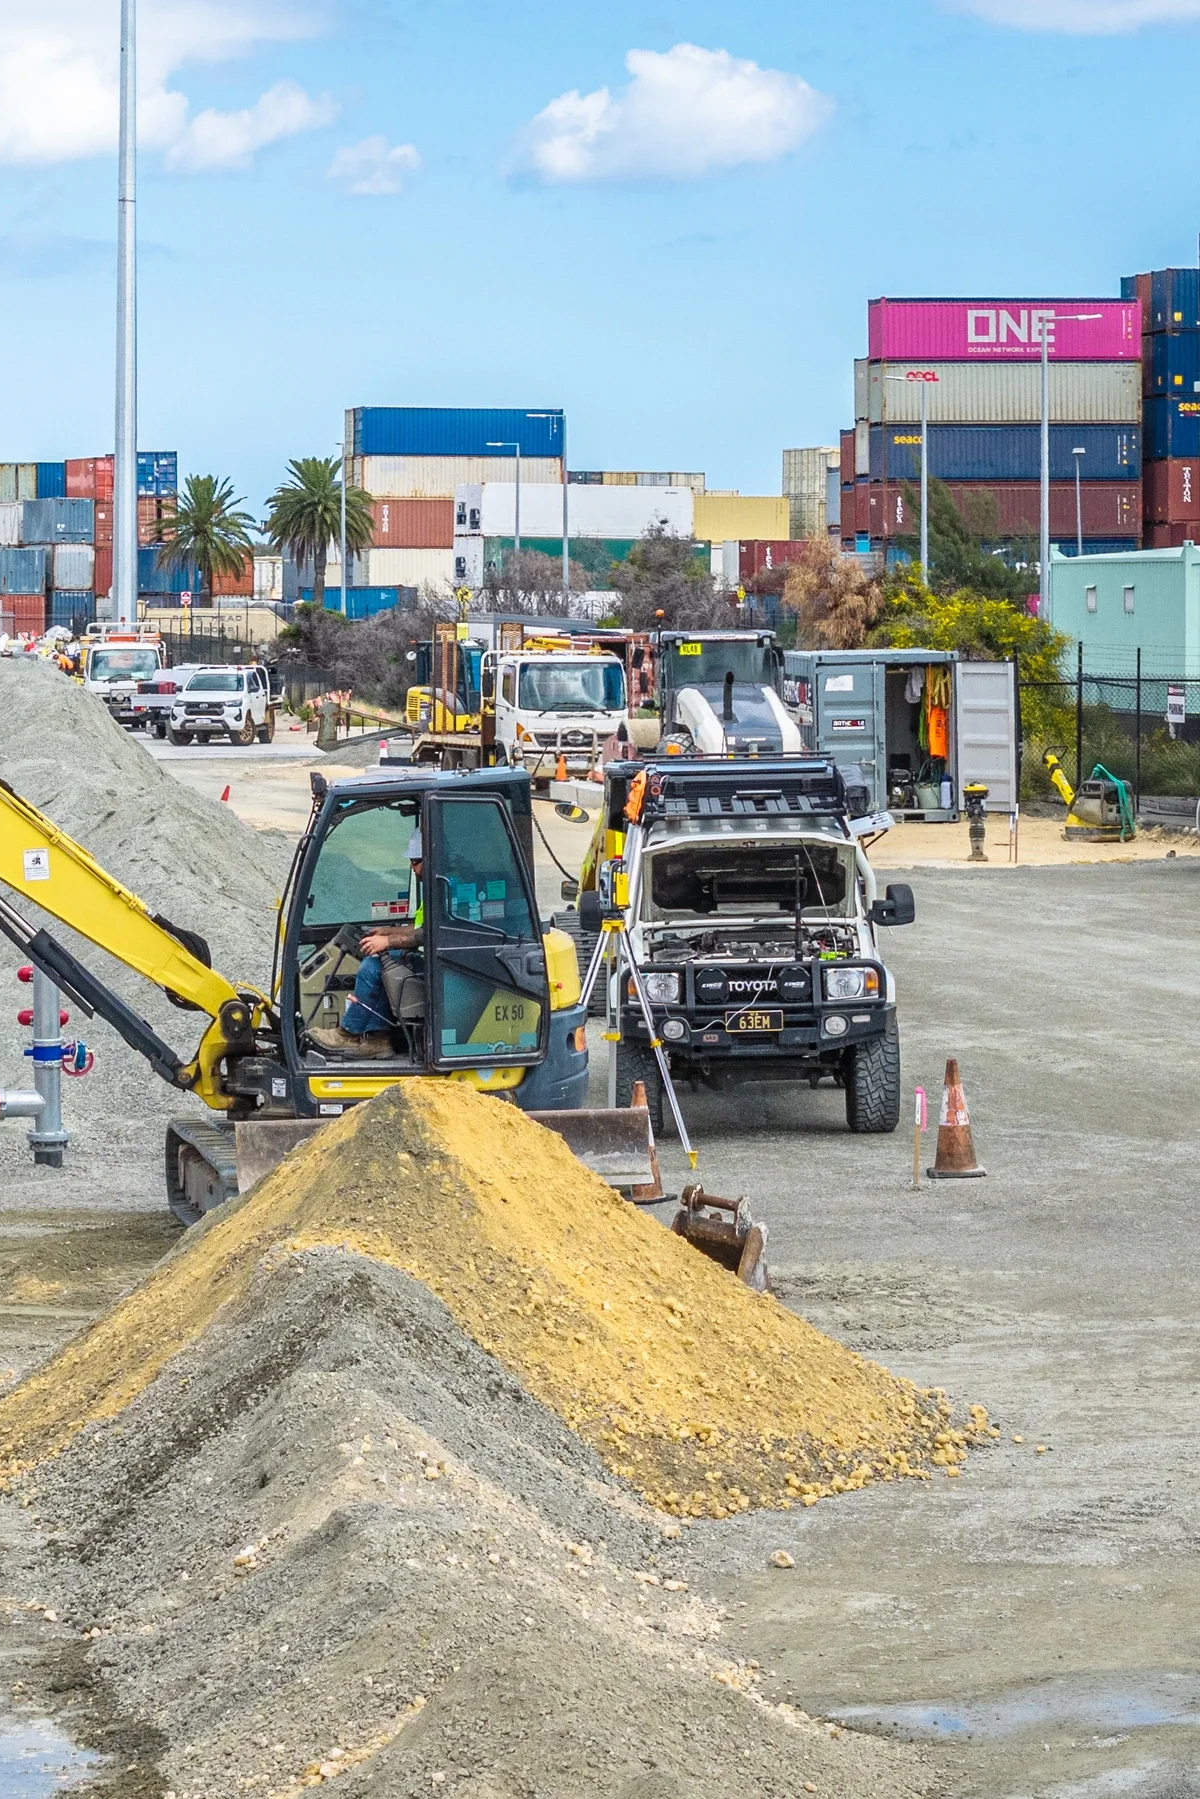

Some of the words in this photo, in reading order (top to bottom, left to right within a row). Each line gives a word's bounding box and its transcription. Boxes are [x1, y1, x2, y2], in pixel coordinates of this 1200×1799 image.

[967, 309, 1056, 343] ONE
[1182, 466, 1192, 503] TRITON
[896, 495, 904, 524] tex
[728, 980, 778, 992] TOYOTA
[494, 1005, 509, 1021] EX
[511, 1004, 524, 1020] 50
